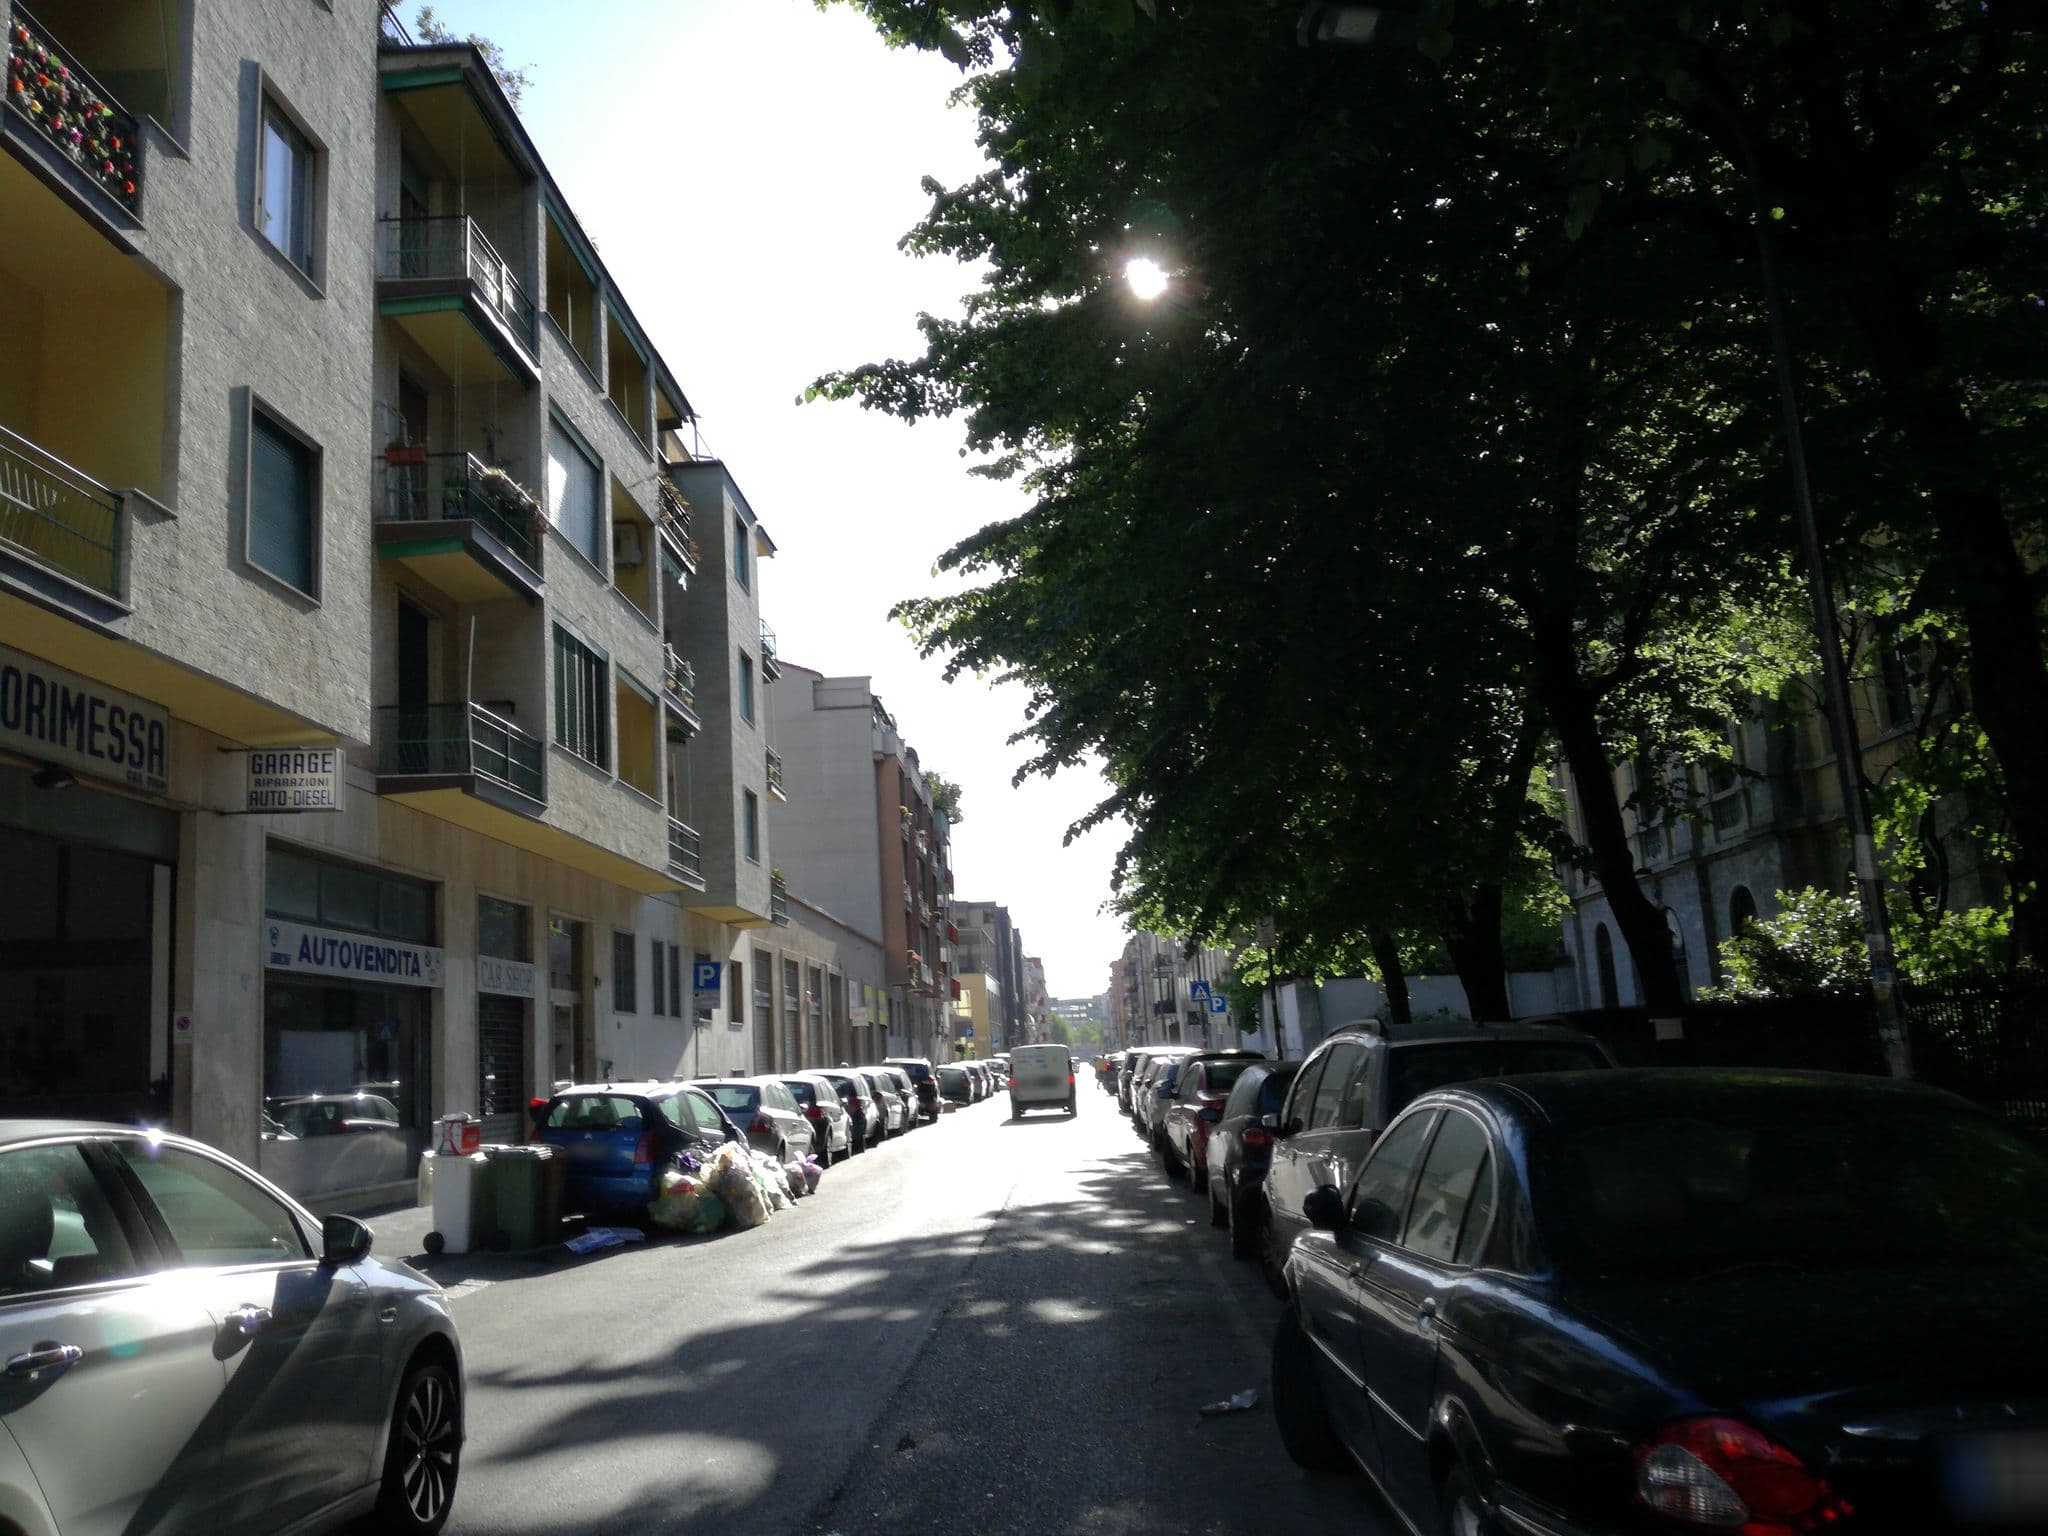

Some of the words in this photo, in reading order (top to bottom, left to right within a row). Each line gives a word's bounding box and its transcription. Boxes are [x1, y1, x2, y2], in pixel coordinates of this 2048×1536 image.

[1, 665, 165, 776] ORIMESSA
[251, 753, 333, 774] GARAGE
[254, 777, 329, 787] RIPARAZIONI
[249, 790, 333, 806] AUTO-DIESEL
[298, 934, 422, 977] AUTOVENDITA
[698, 965, 715, 987] P
[1212, 998, 1223, 1012] P
